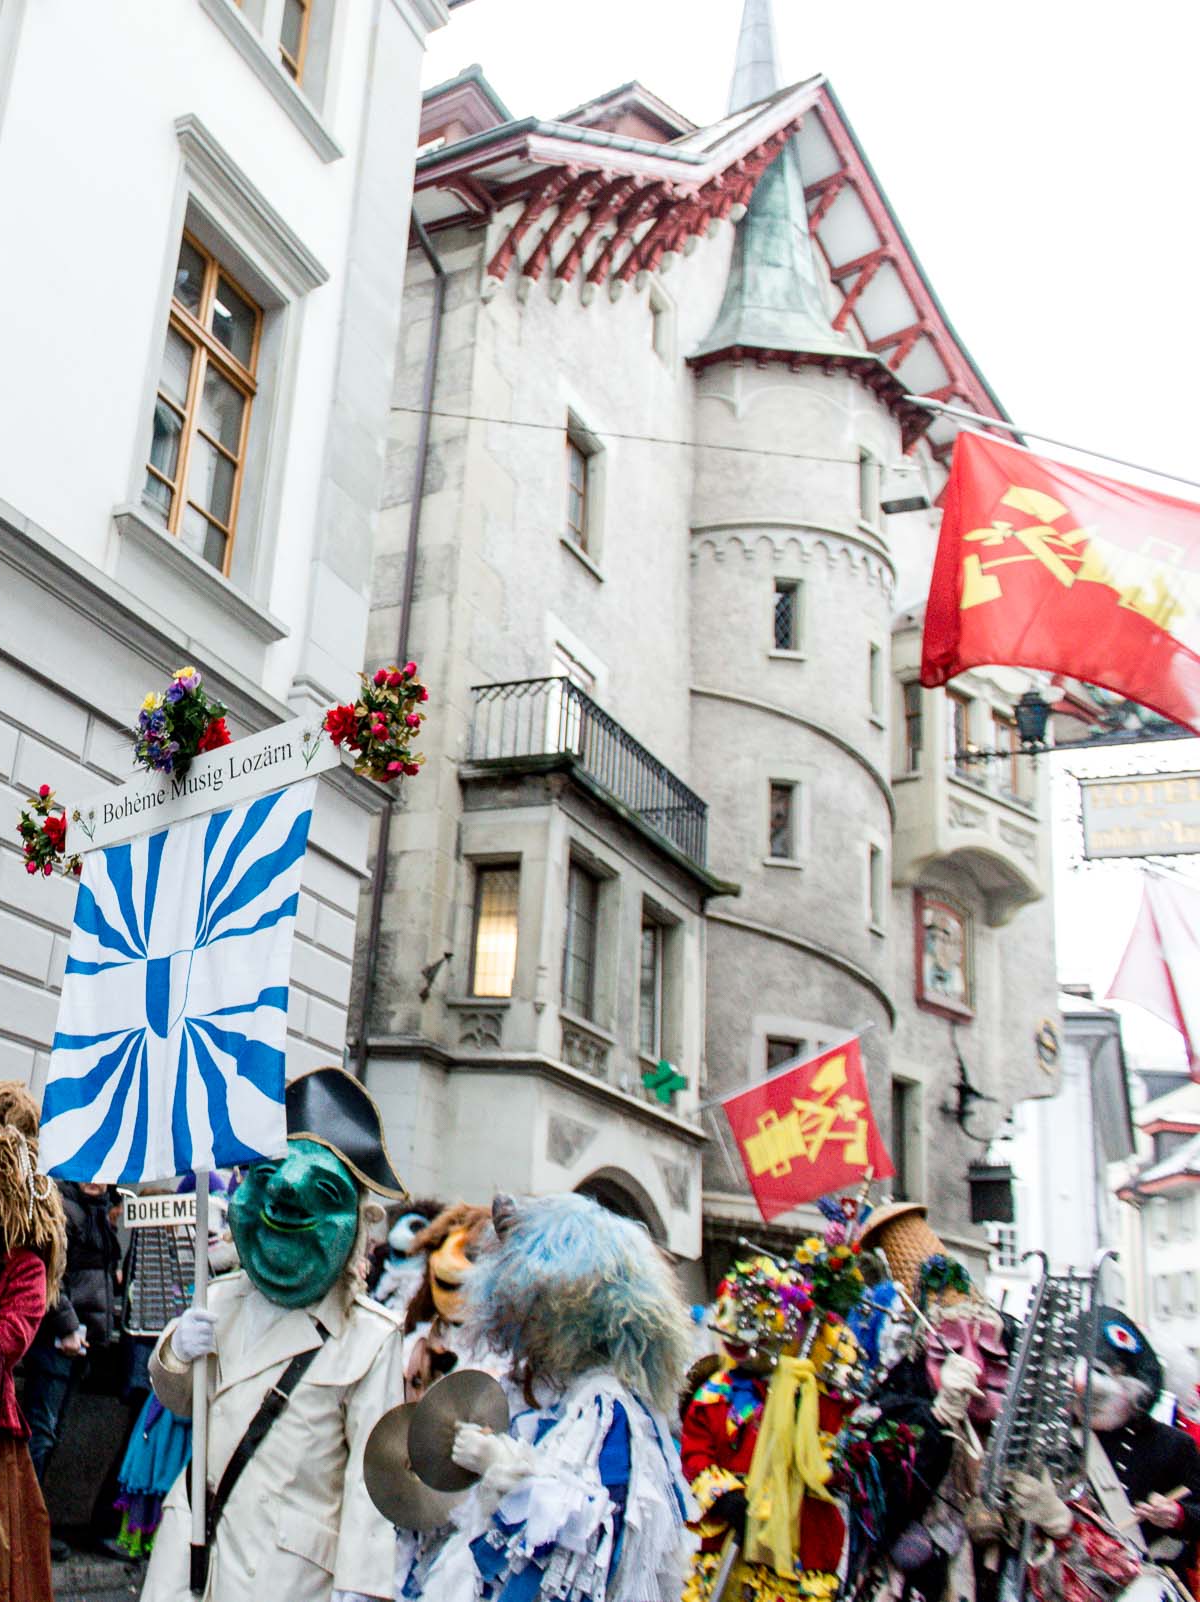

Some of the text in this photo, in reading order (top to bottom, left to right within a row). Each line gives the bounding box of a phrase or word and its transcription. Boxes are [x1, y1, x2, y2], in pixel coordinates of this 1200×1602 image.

[103, 743, 292, 824] Bohème Musig Lozärn
